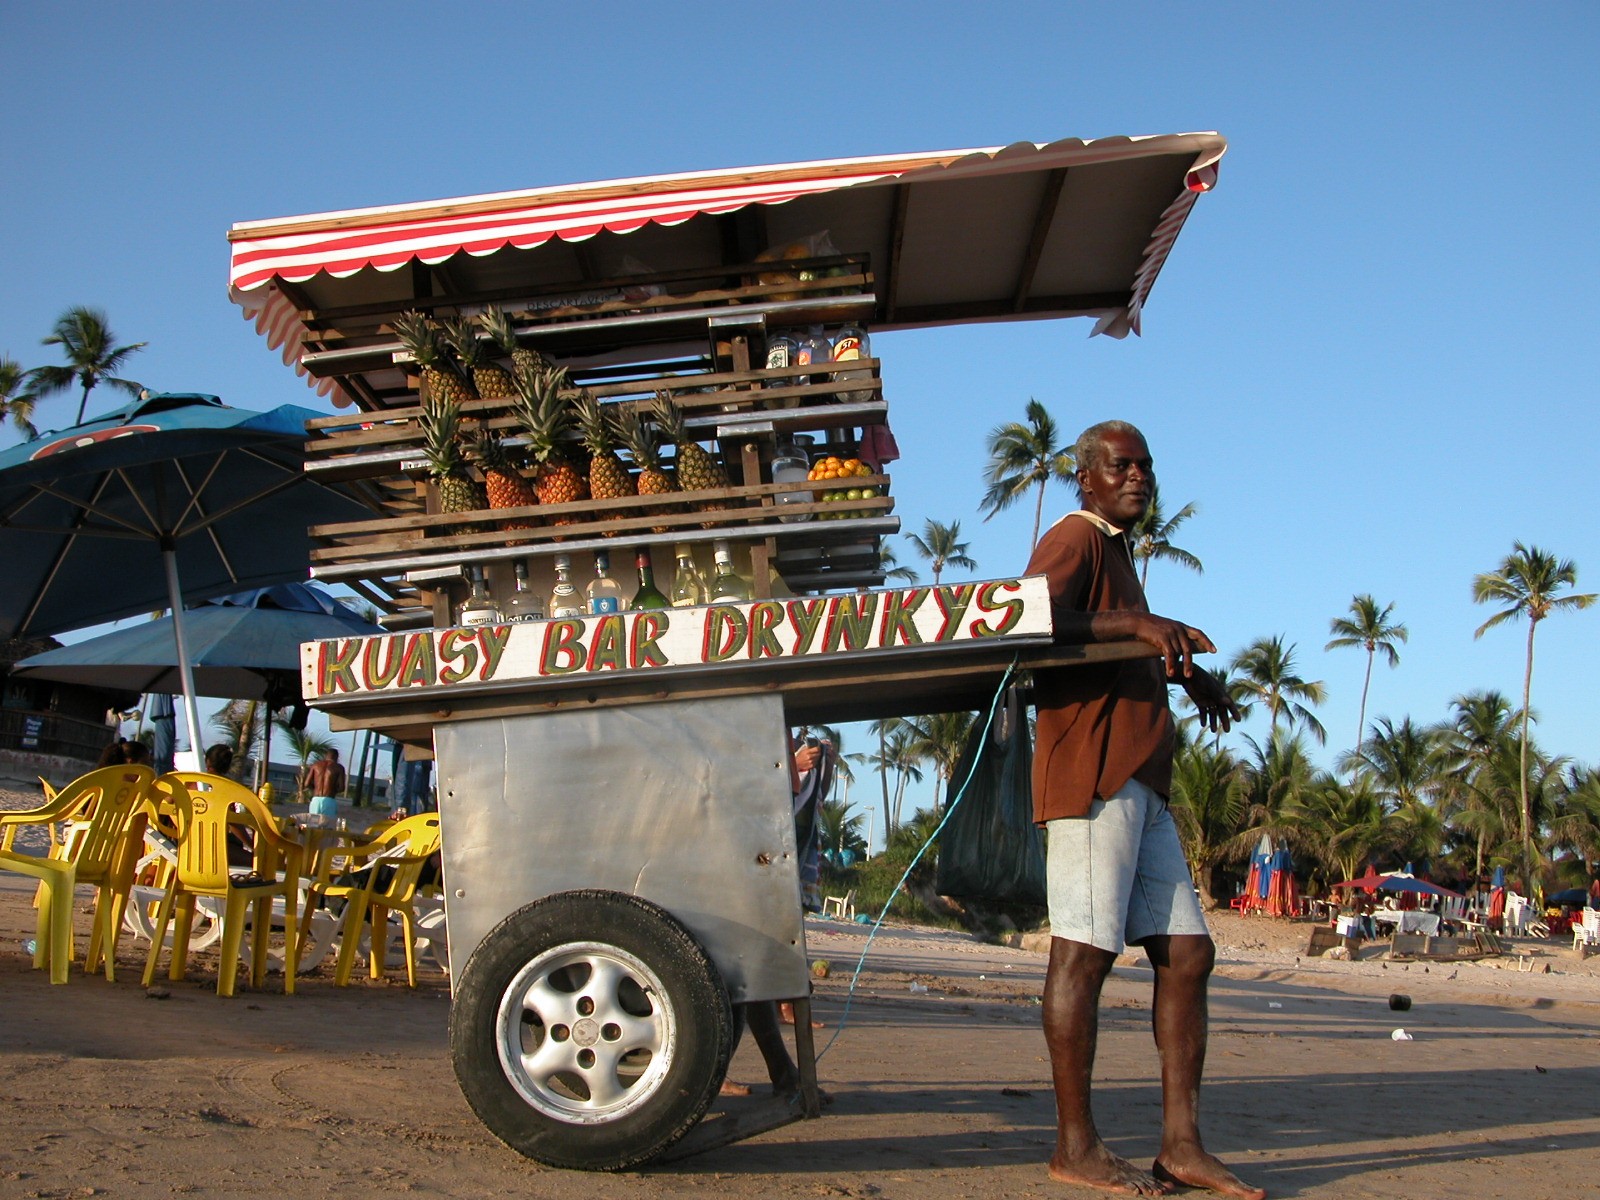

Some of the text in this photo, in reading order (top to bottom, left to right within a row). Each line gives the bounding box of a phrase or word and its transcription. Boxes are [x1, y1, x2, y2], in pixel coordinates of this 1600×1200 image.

[317, 579, 1025, 695] KUASY BAR DRYNKYS
